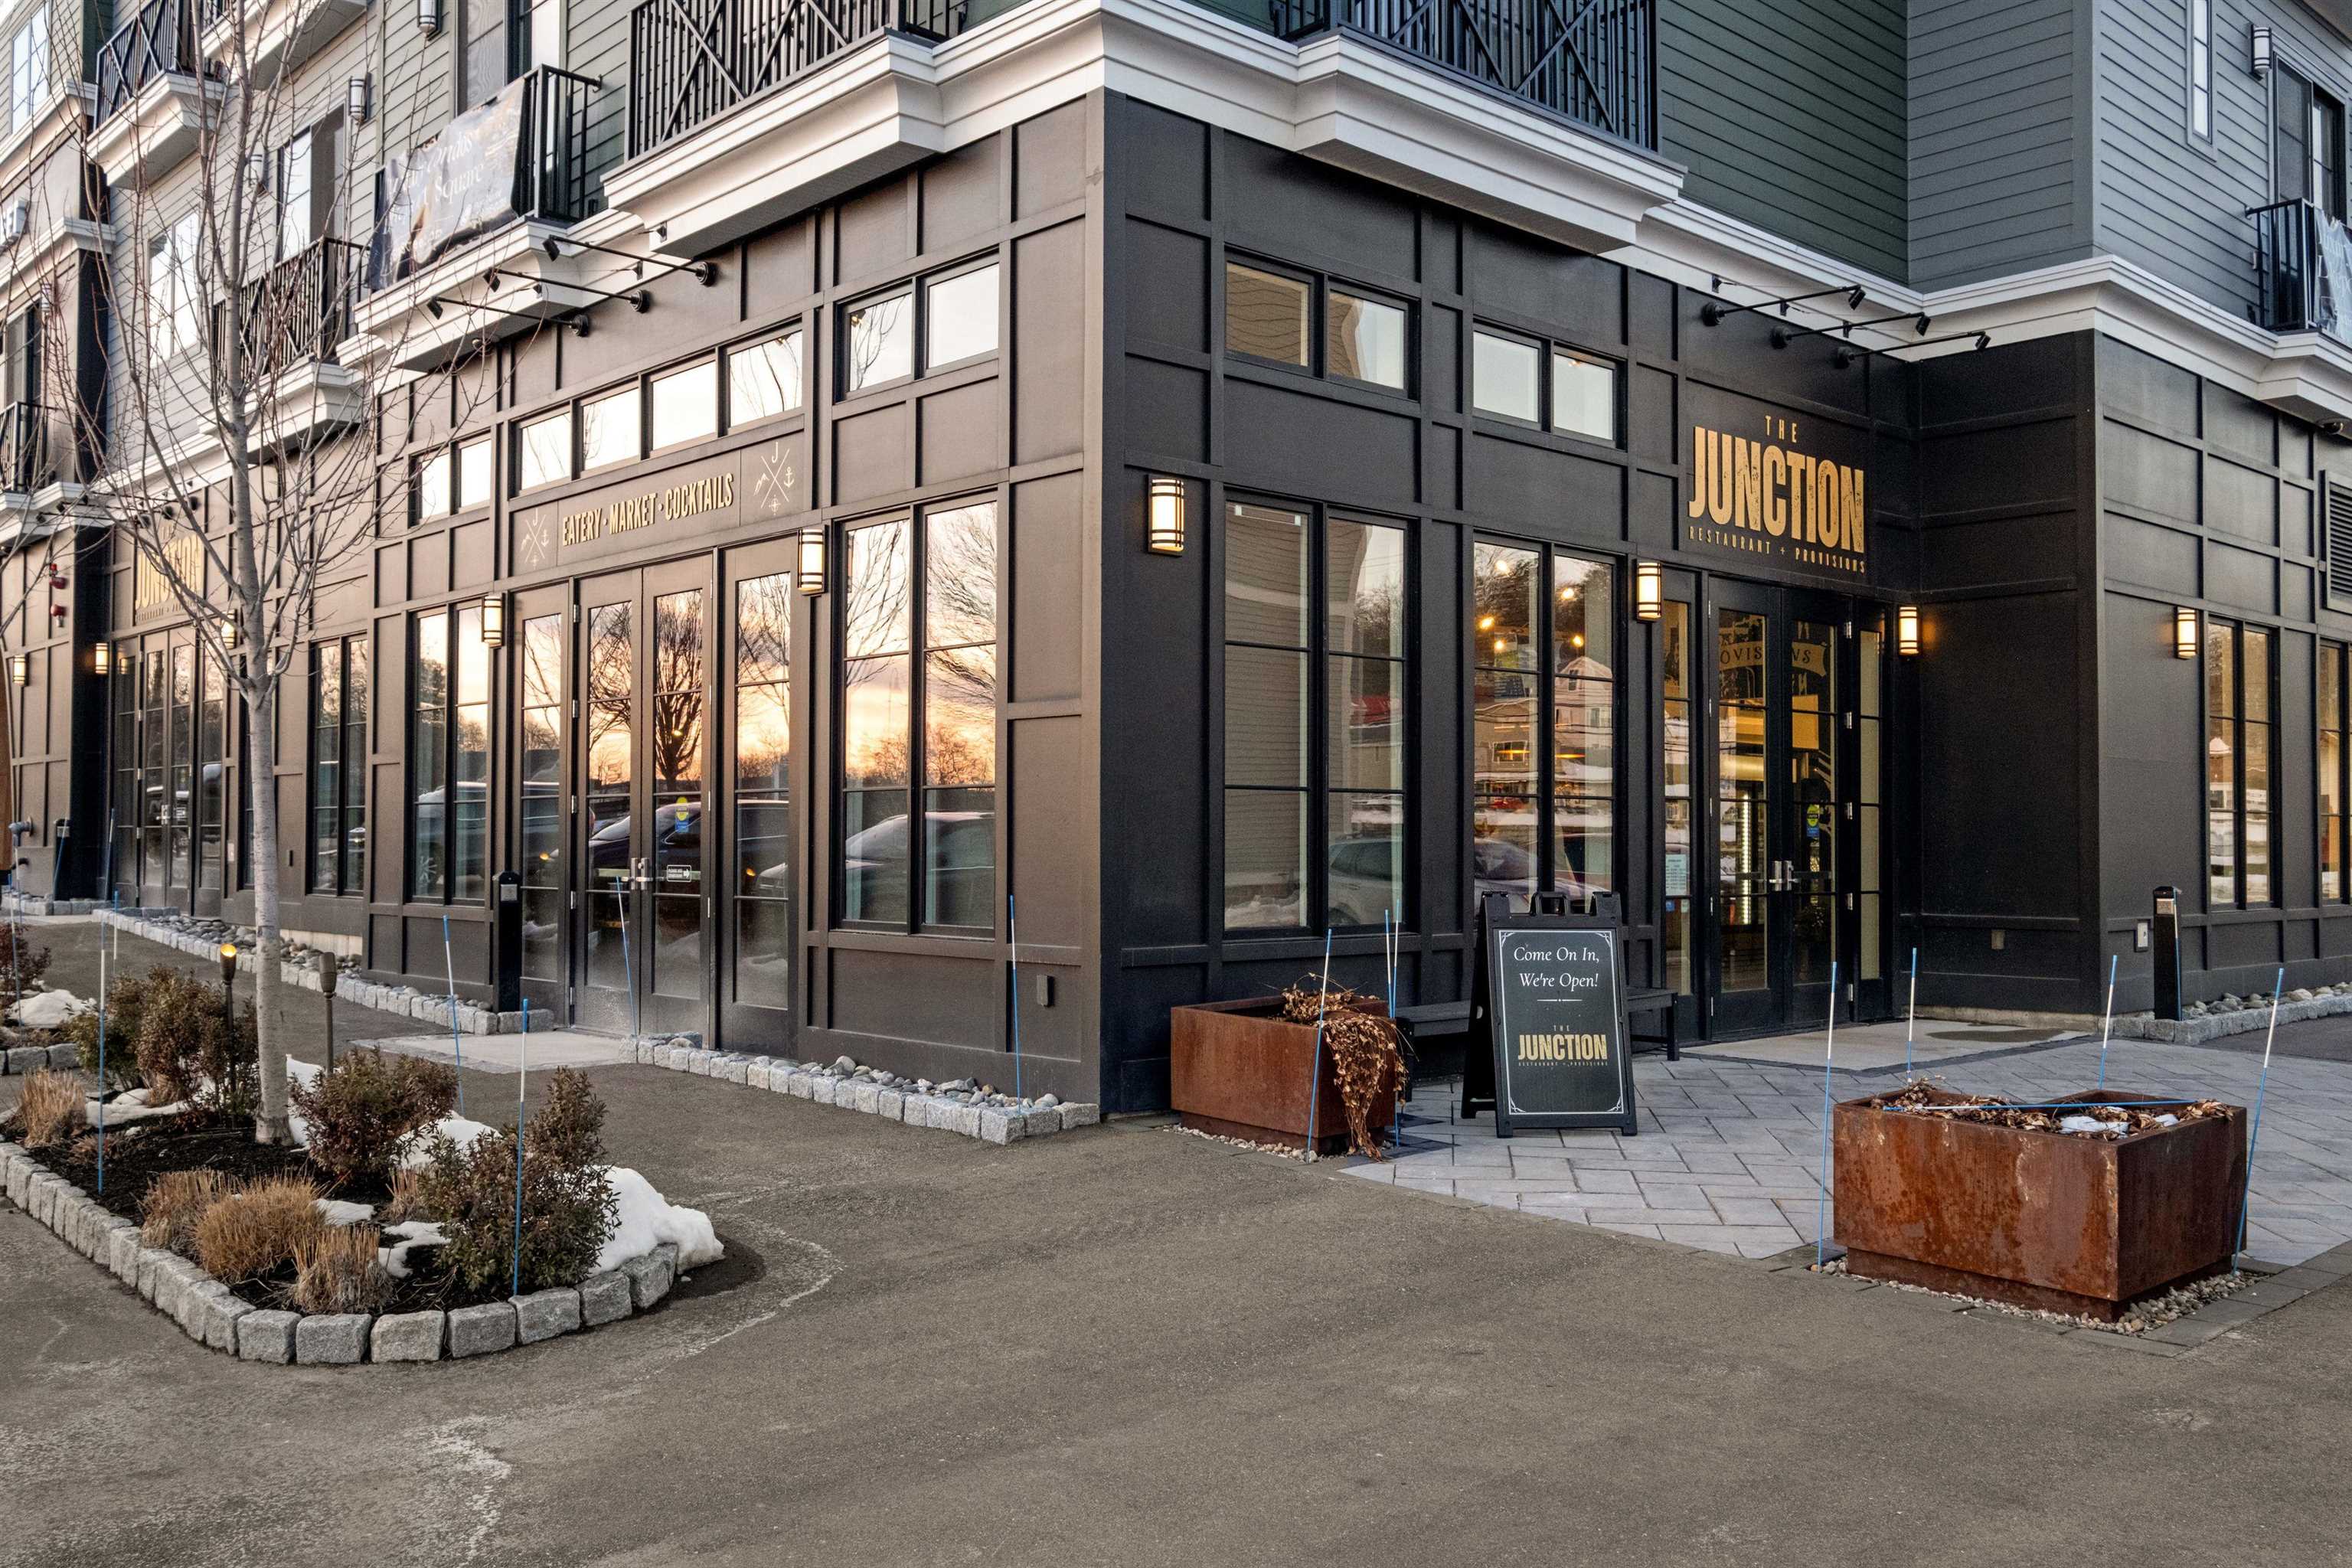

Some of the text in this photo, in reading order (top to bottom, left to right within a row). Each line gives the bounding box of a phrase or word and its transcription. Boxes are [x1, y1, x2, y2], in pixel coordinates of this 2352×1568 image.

[1765, 415, 1797, 443] THE
[1689, 426, 1864, 554] JUNCTION
[562, 472, 734, 546] EATERY MARKET COCKTAILS
[1689, 526, 1770, 554] RESTAURANT
[1795, 547, 1867, 573] PROVISIONS
[1514, 946, 1600, 963] Come On In,
[1520, 973, 1599, 991] We're Open!
[1517, 1034, 1608, 1060] JUNCTION
